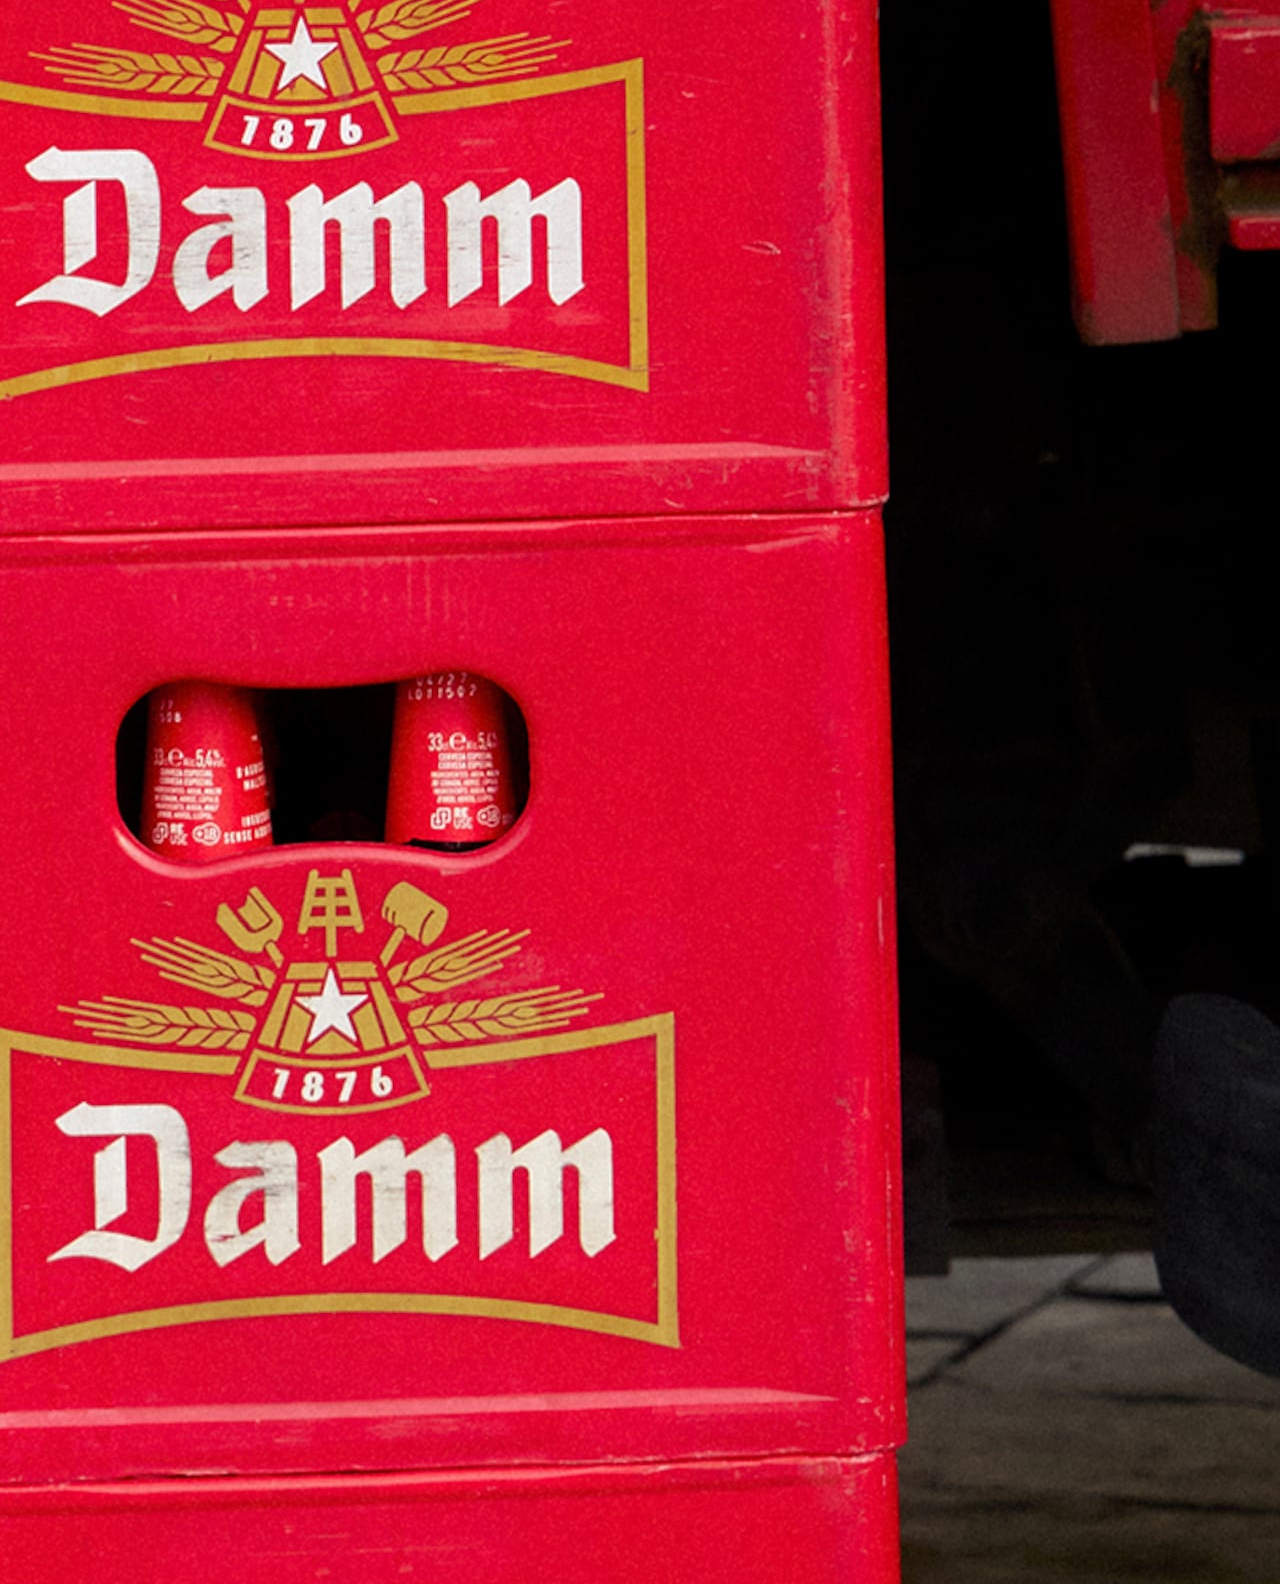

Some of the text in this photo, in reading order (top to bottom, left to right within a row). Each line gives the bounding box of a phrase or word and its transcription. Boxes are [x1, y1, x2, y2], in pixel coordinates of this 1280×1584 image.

[240, 113, 364, 150] 1876
[14, 145, 587, 318] Damm
[270, 1065, 395, 1103] 1876
[45, 1100, 618, 1273] Damm
